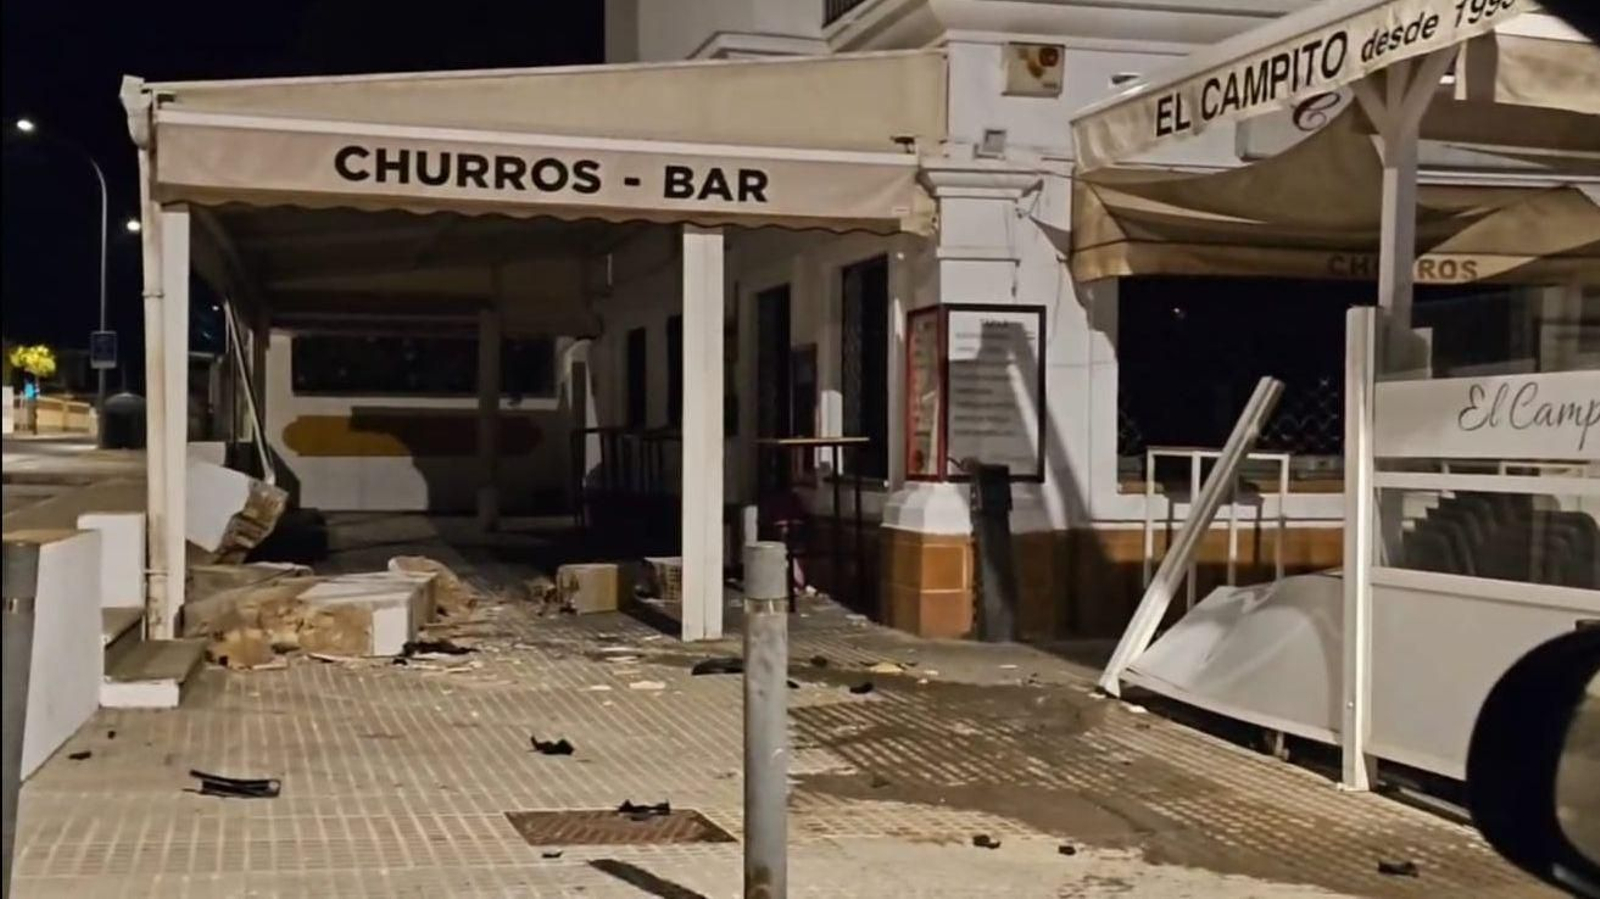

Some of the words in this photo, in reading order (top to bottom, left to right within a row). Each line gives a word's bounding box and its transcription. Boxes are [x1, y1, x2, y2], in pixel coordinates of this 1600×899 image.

[1156, 92, 1191, 137] EL
[1201, 31, 1348, 121] CAMPITO
[1361, 11, 1439, 62] desde
[334, 145, 602, 194] CHURROS
[624, 177, 641, 186] -
[663, 165, 769, 203] BAR
[1327, 254, 1478, 281] CHROS
[1458, 383, 1508, 431] El
